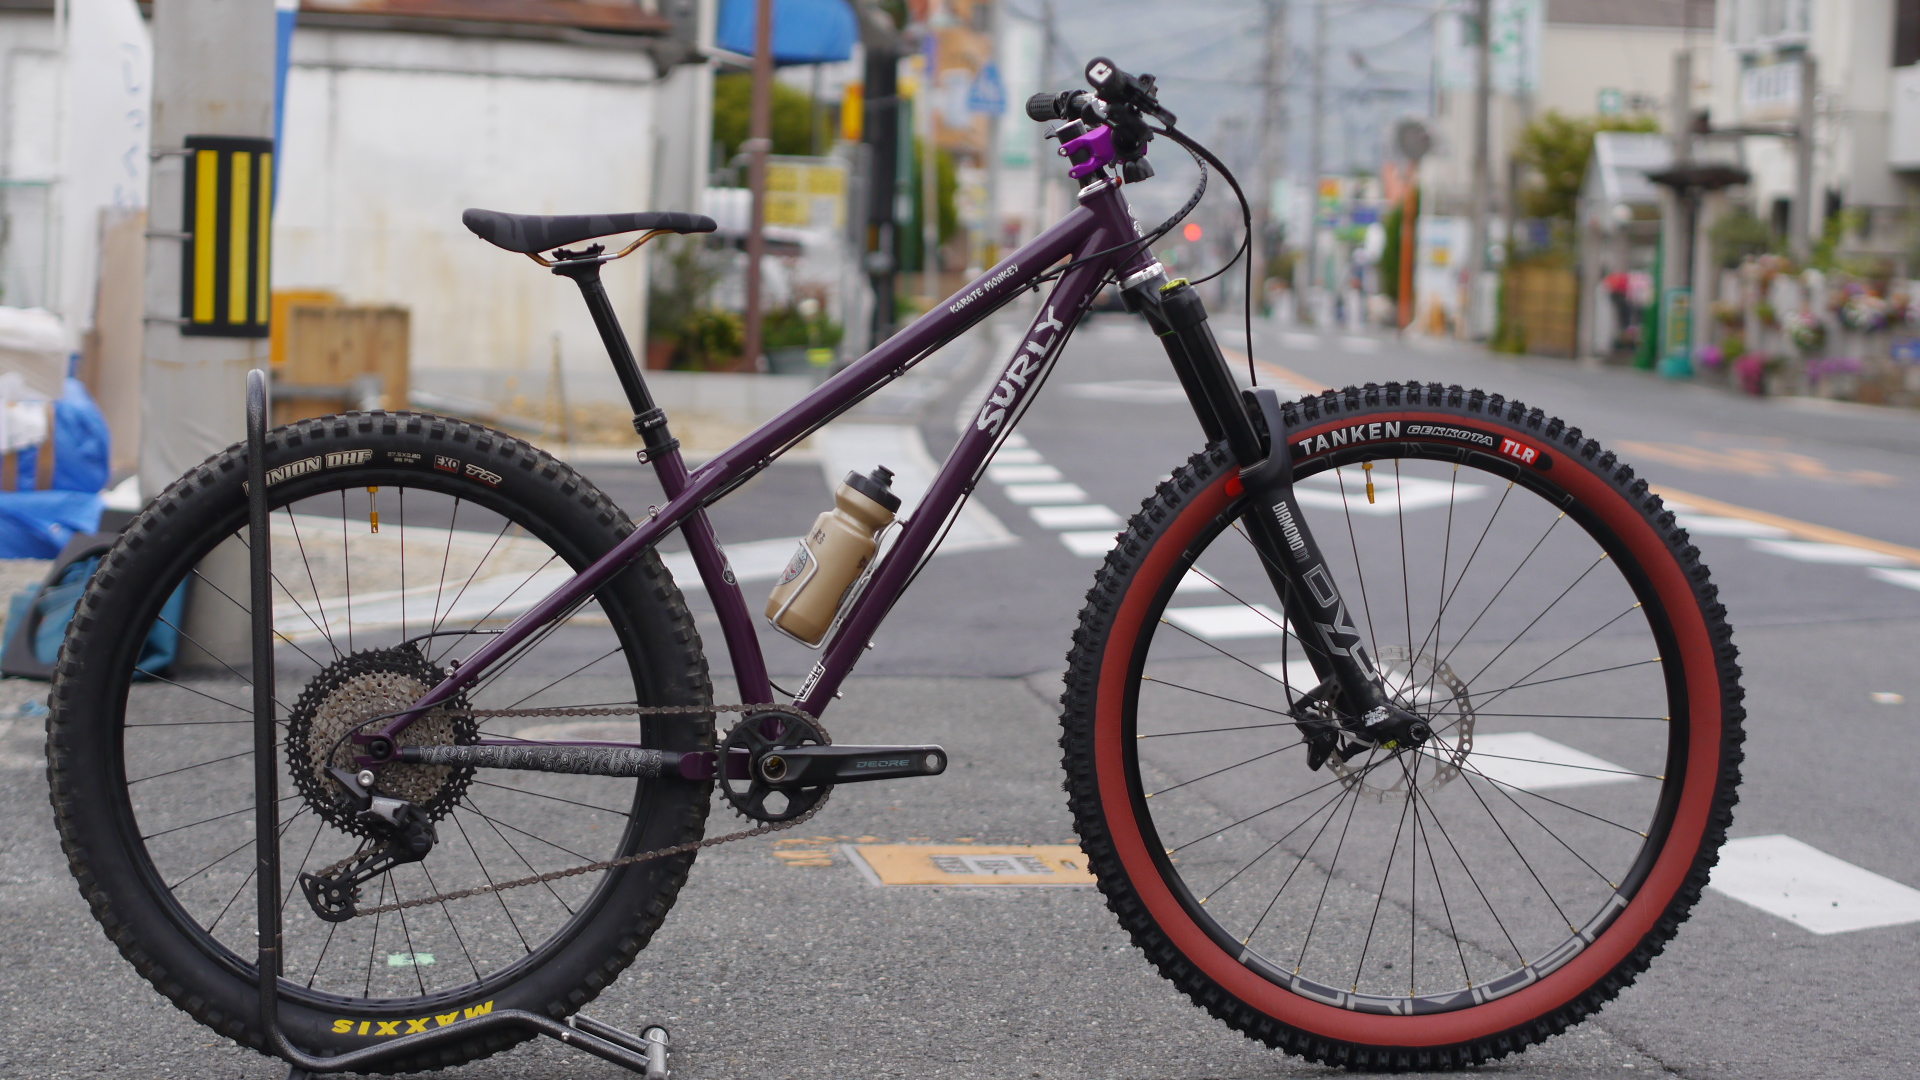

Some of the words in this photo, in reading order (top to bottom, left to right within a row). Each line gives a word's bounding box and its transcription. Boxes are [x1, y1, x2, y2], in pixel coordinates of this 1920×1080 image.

[950, 288, 983, 314] KARATE
[984, 263, 1019, 292] MONKEY
[976, 304, 1064, 438] SURLY
[435, 455, 459, 470] EXO
[1299, 421, 1400, 456] TANKEN
[1406, 425, 1493, 446] GEKKOTA
[1501, 438, 1540, 464] TLR
[242, 456, 322, 497] INION
[326, 449, 372, 468] DHF
[465, 463, 502, 485] TR
[1272, 501, 1305, 551] DIAMOND
[856, 759, 910, 768] DEORE
[331, 1000, 494, 1036] MAXXIS
